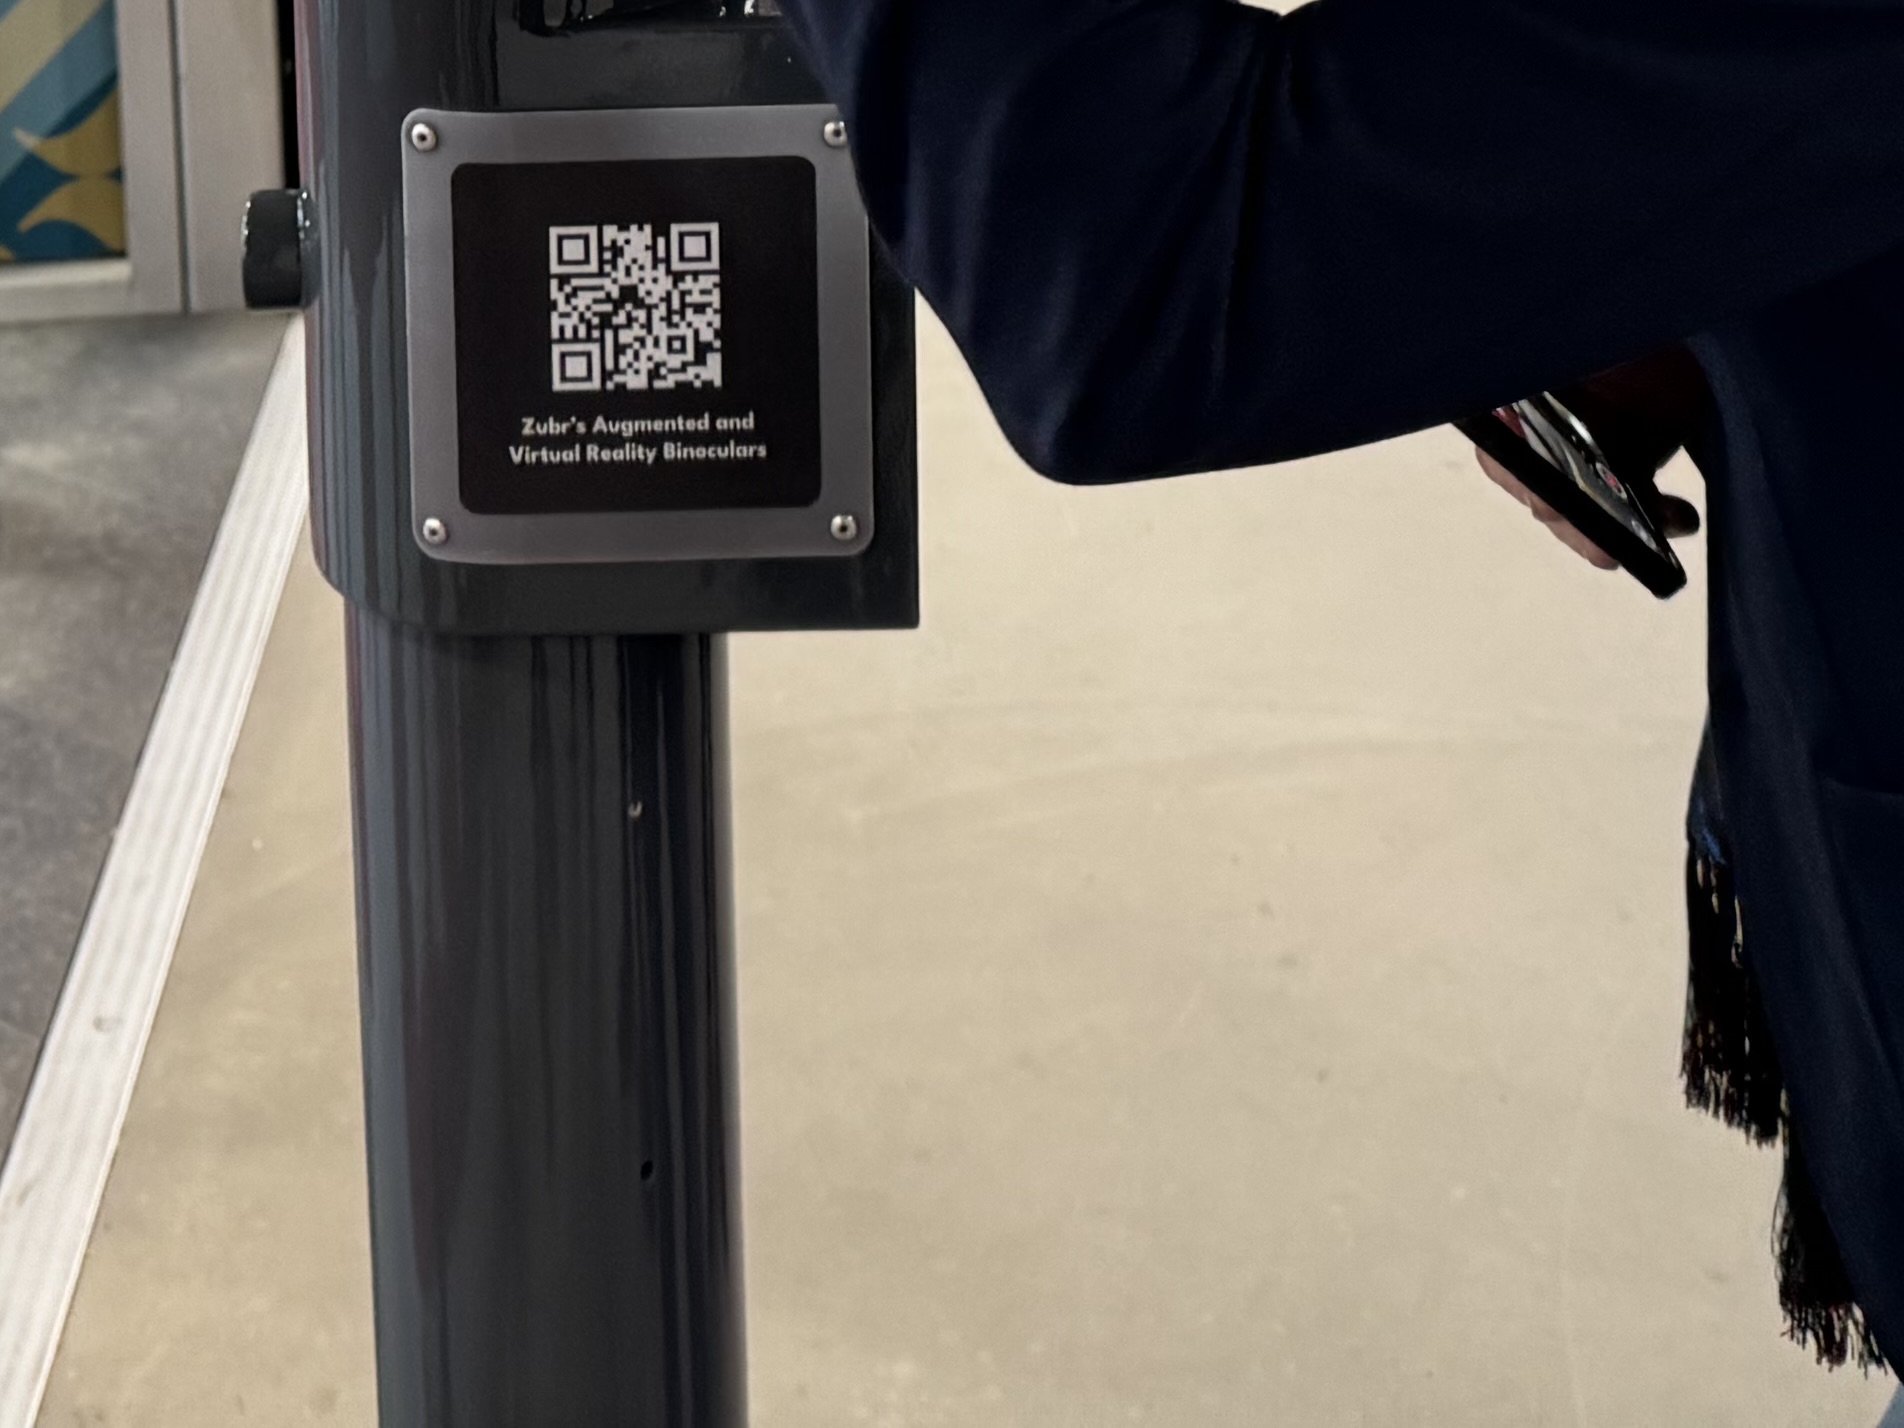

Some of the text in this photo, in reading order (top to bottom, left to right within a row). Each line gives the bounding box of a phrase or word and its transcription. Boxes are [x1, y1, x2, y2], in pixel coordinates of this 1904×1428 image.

[521, 410, 755, 437] Zubr's Augmented and
[509, 439, 767, 465] Virtual Reality Binoculars
